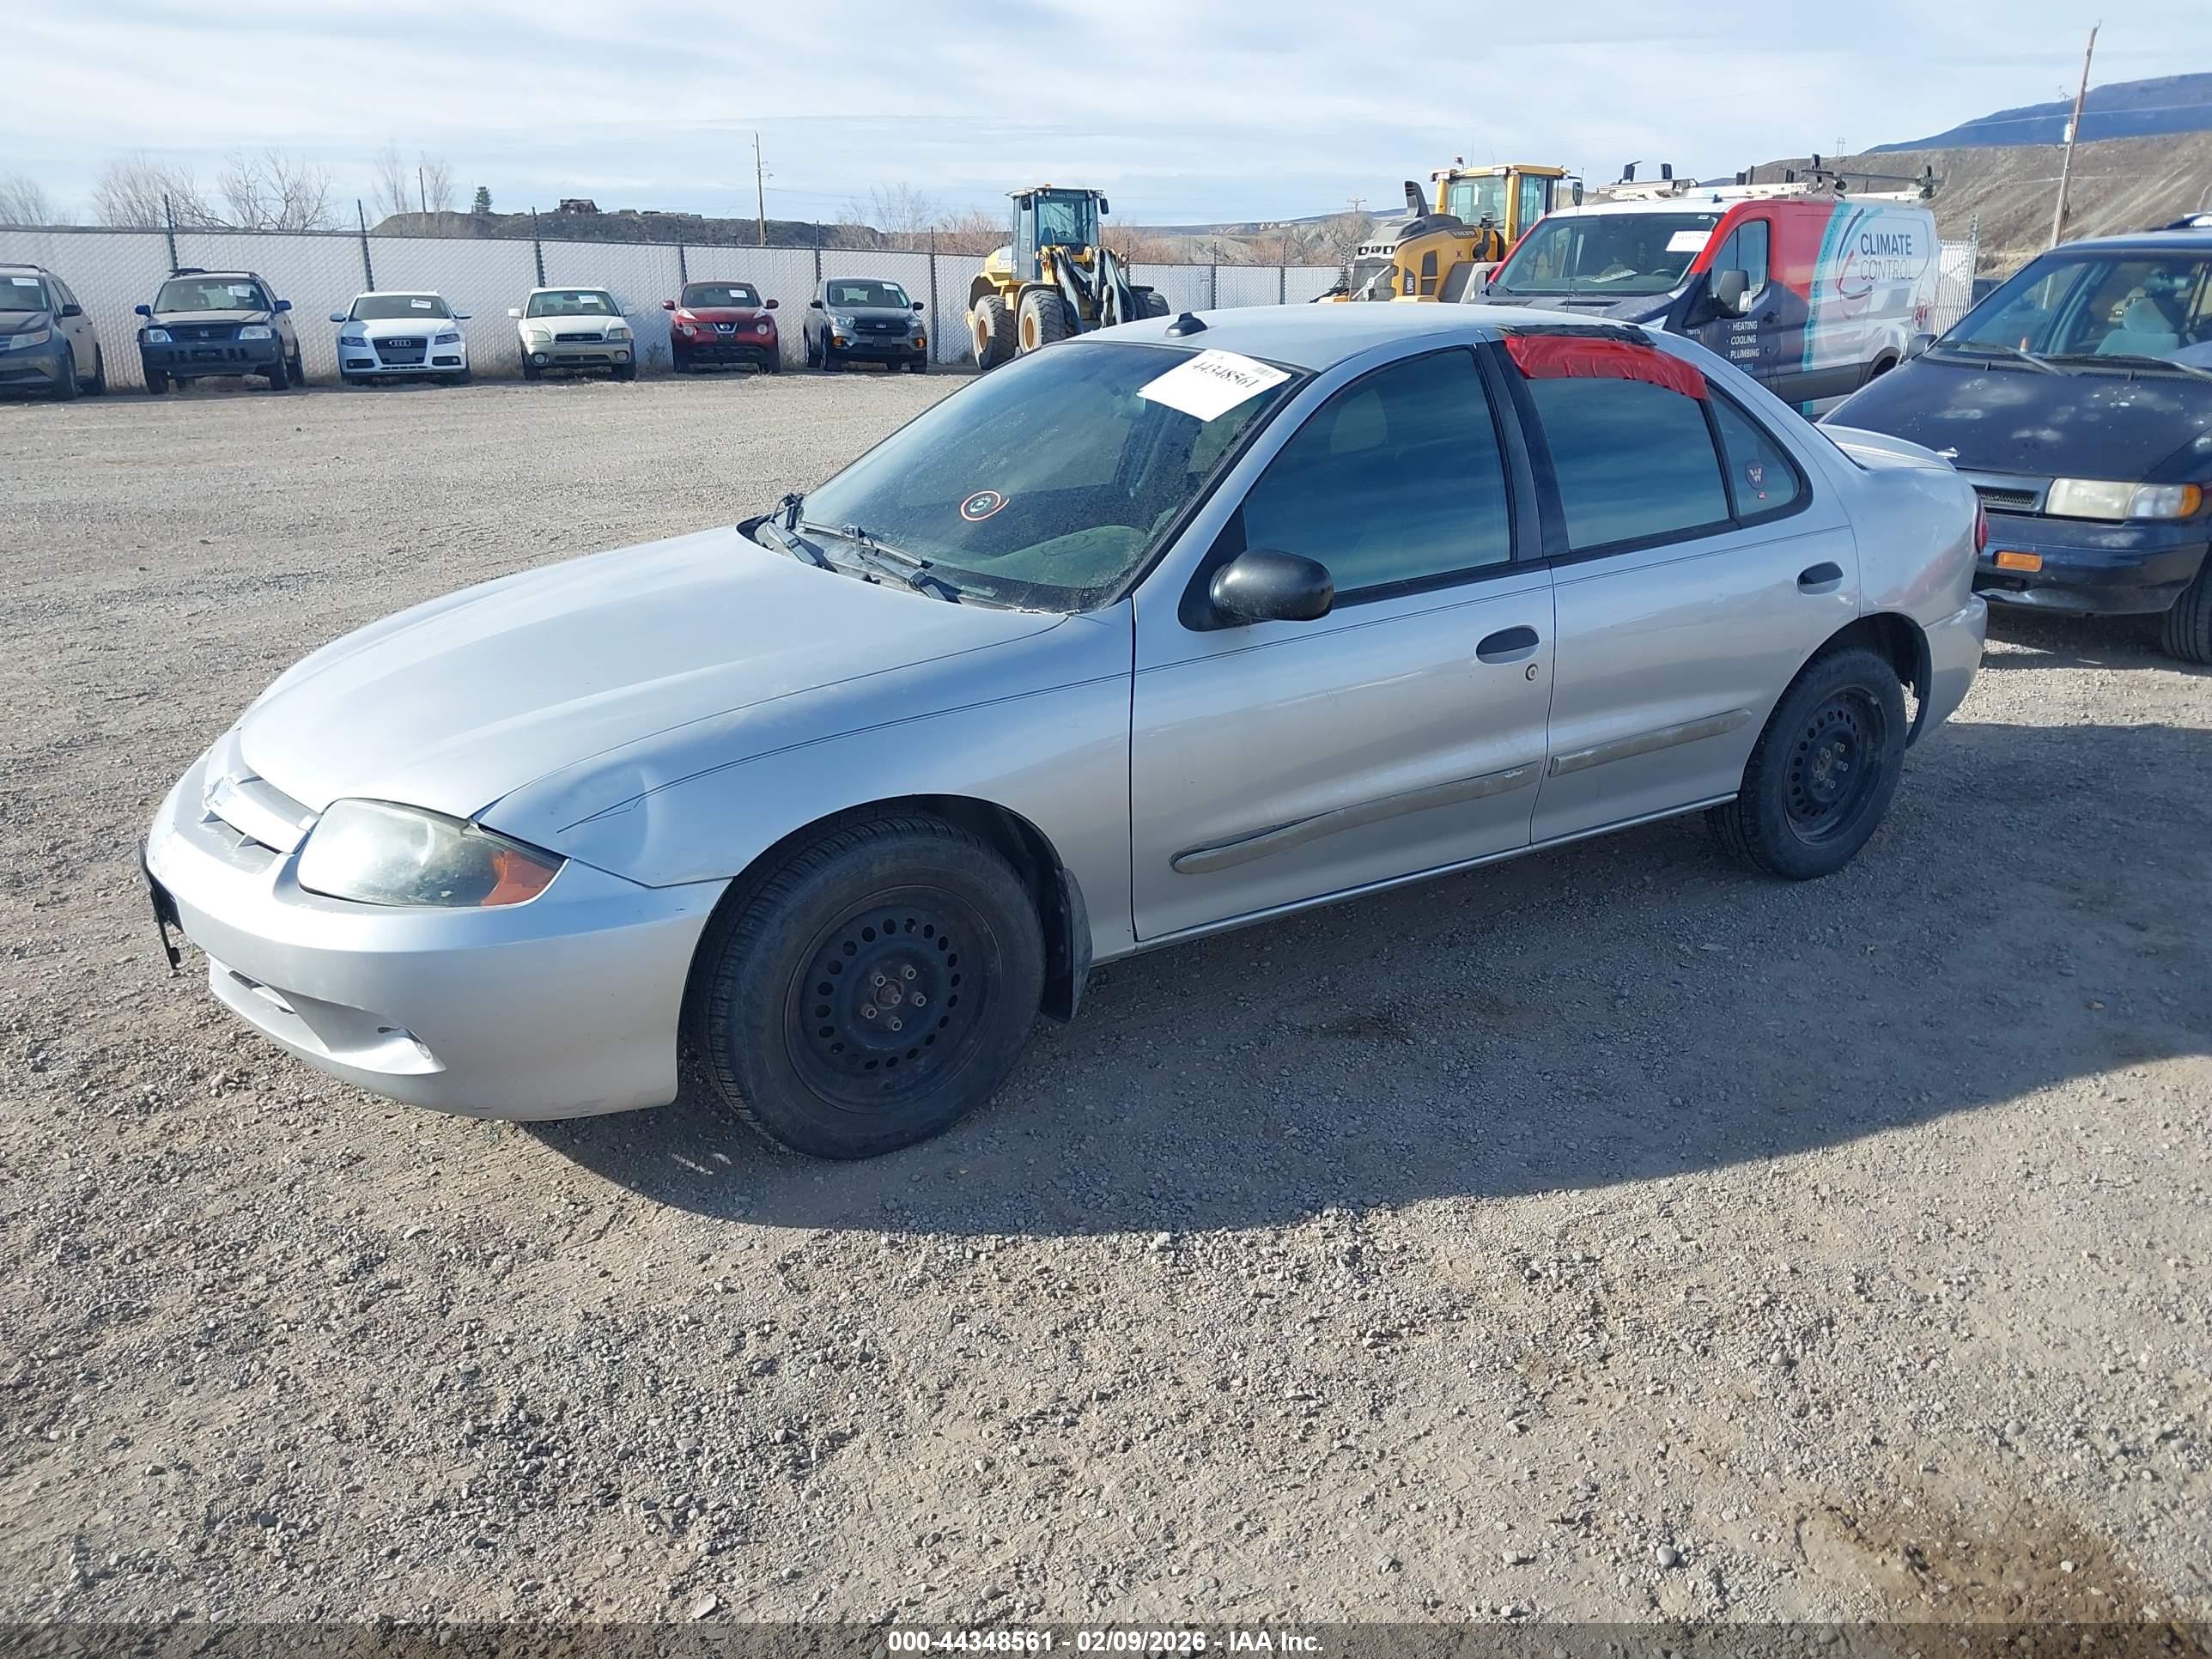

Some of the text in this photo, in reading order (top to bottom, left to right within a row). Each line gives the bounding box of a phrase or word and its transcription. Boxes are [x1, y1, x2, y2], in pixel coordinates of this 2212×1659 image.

[1860, 233, 1913, 256] CLIMATE
[1860, 259, 1913, 281] CONTROL
[1732, 321, 1758, 331] HEATING
[1730, 335, 1757, 345] COOLING
[1730, 348, 1760, 359] PLUMBING
[1193, 362, 1260, 388] 44348561
